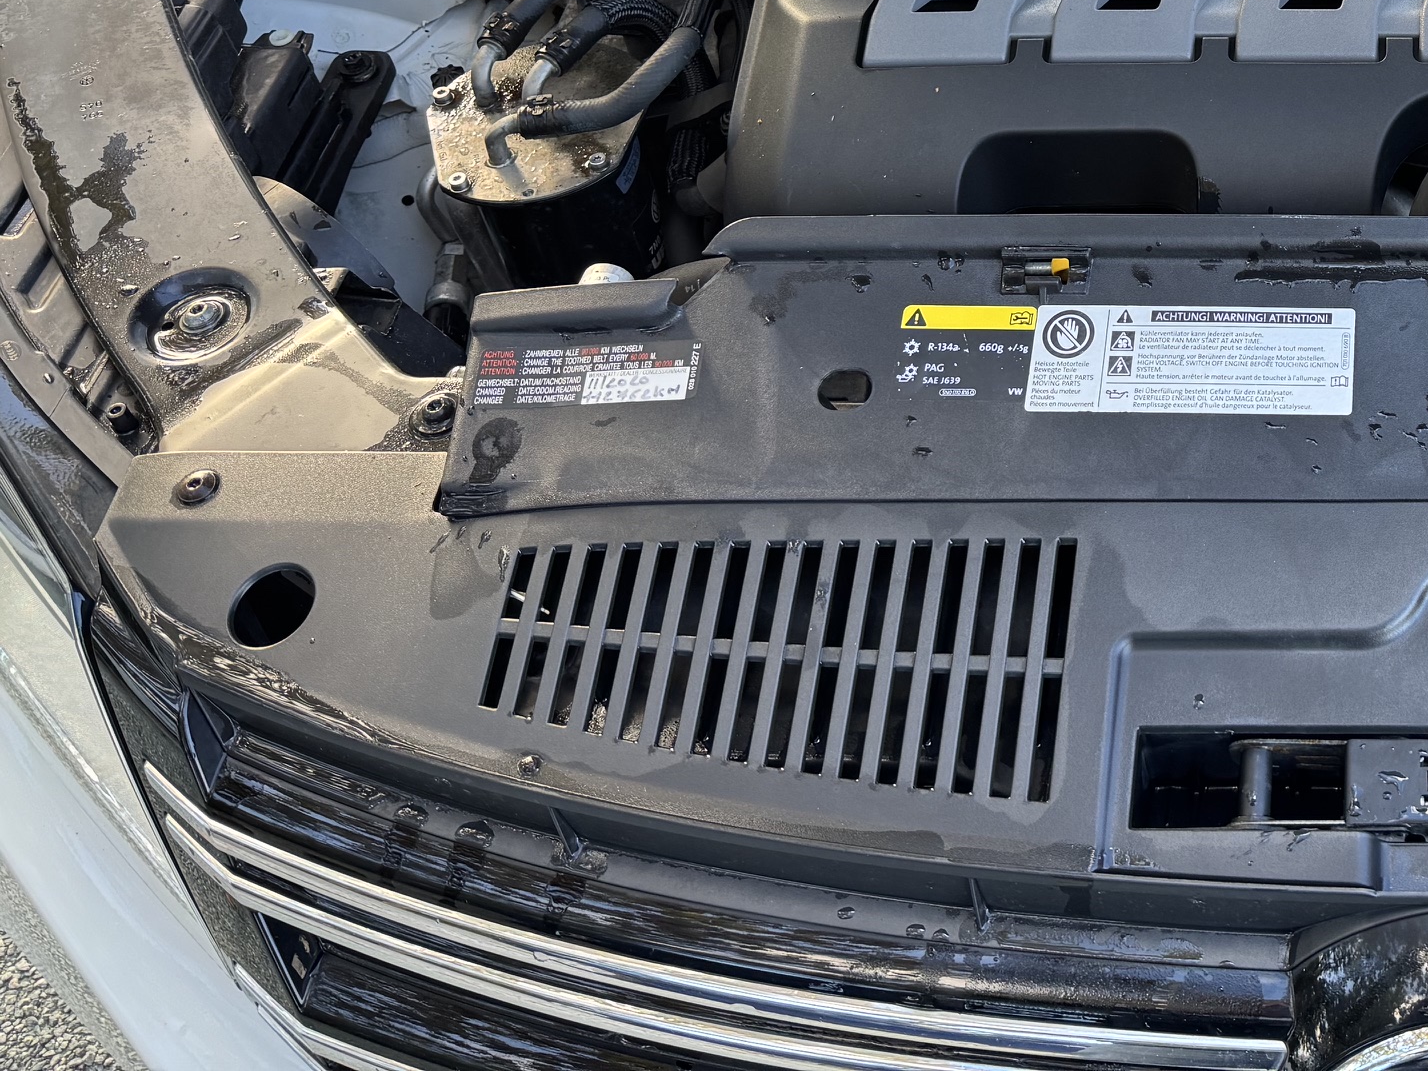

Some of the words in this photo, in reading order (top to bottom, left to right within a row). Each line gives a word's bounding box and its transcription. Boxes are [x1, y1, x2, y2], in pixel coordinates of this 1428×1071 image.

[1156, 312, 1209, 321] ACHTUNG!
[1213, 312, 1266, 322] WARNING!
[1269, 313, 1328, 323] ATTENTION!
[611, 345, 643, 353] WECHSELN
[979, 343, 1004, 354] 660g
[565, 355, 591, 365] TOOTHED
[593, 354, 607, 363] BELT
[609, 354, 628, 362] EVERY
[691, 351, 699, 365] 227
[594, 361, 621, 370] CRANTEE
[624, 361, 639, 369] TOUS
[924, 363, 945, 372] PAG
[940, 376, 960, 384] J639
[476, 388, 506, 396] CHANGED
[474, 396, 504, 404] CHANGEE
[1221, 402, 1255, 410] dangereux
